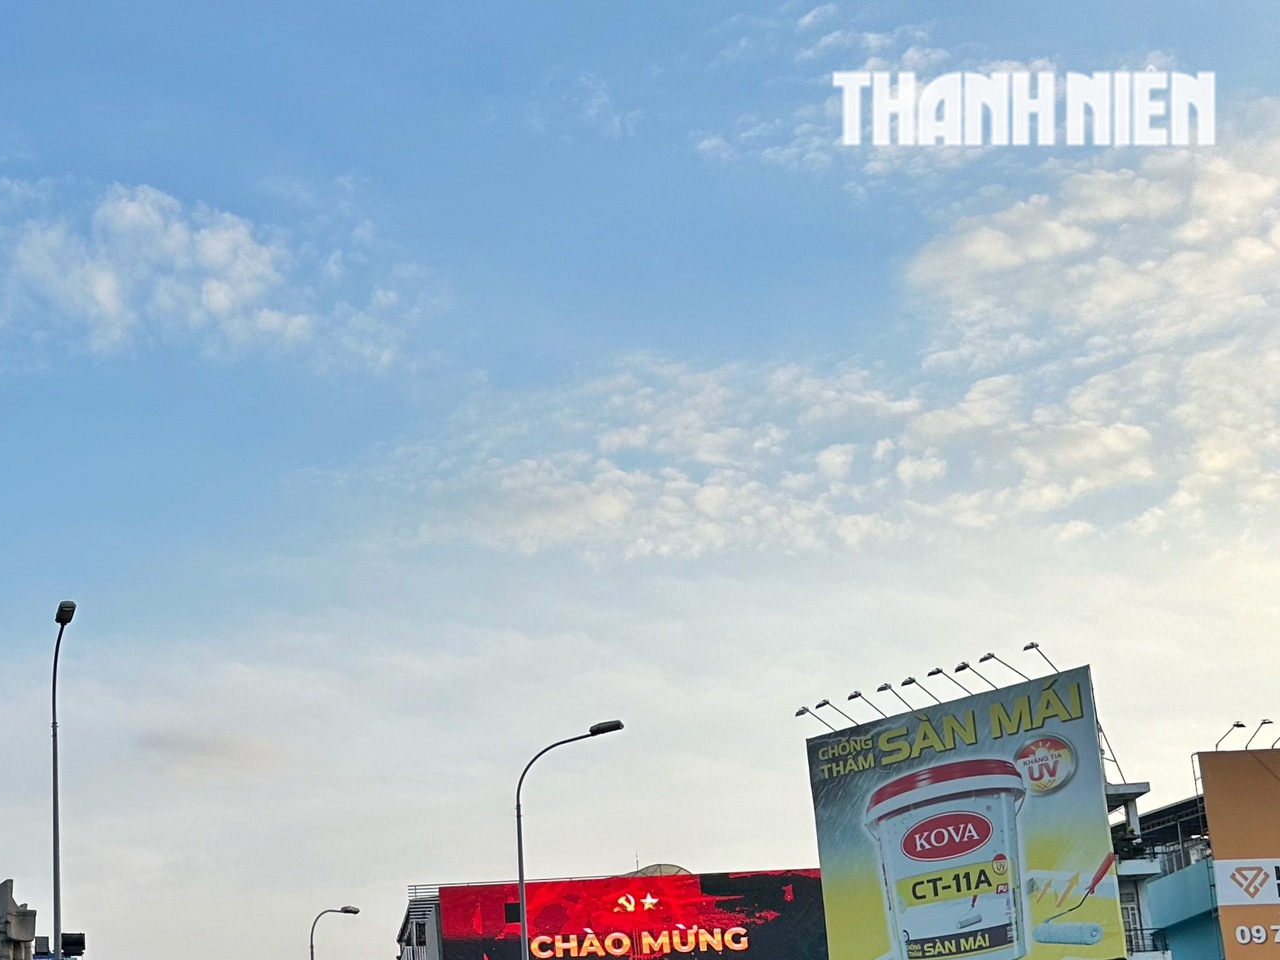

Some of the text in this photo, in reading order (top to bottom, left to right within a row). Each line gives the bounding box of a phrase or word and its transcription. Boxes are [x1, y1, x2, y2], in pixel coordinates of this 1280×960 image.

[878, 679, 1084, 766] SÀN MÁI
[818, 737, 873, 761] CHỐNG
[1050, 752, 1062, 761] TIA
[821, 751, 875, 779] THẤM
[1028, 760, 1060, 782] UV
[914, 822, 980, 852] KOVA
[912, 869, 993, 900] CT-11A
[997, 884, 1008, 894] PU
[530, 923, 749, 959] CHÀO MỪNG
[923, 939, 957, 956] SÀN
[960, 931, 990, 951] MÁI
